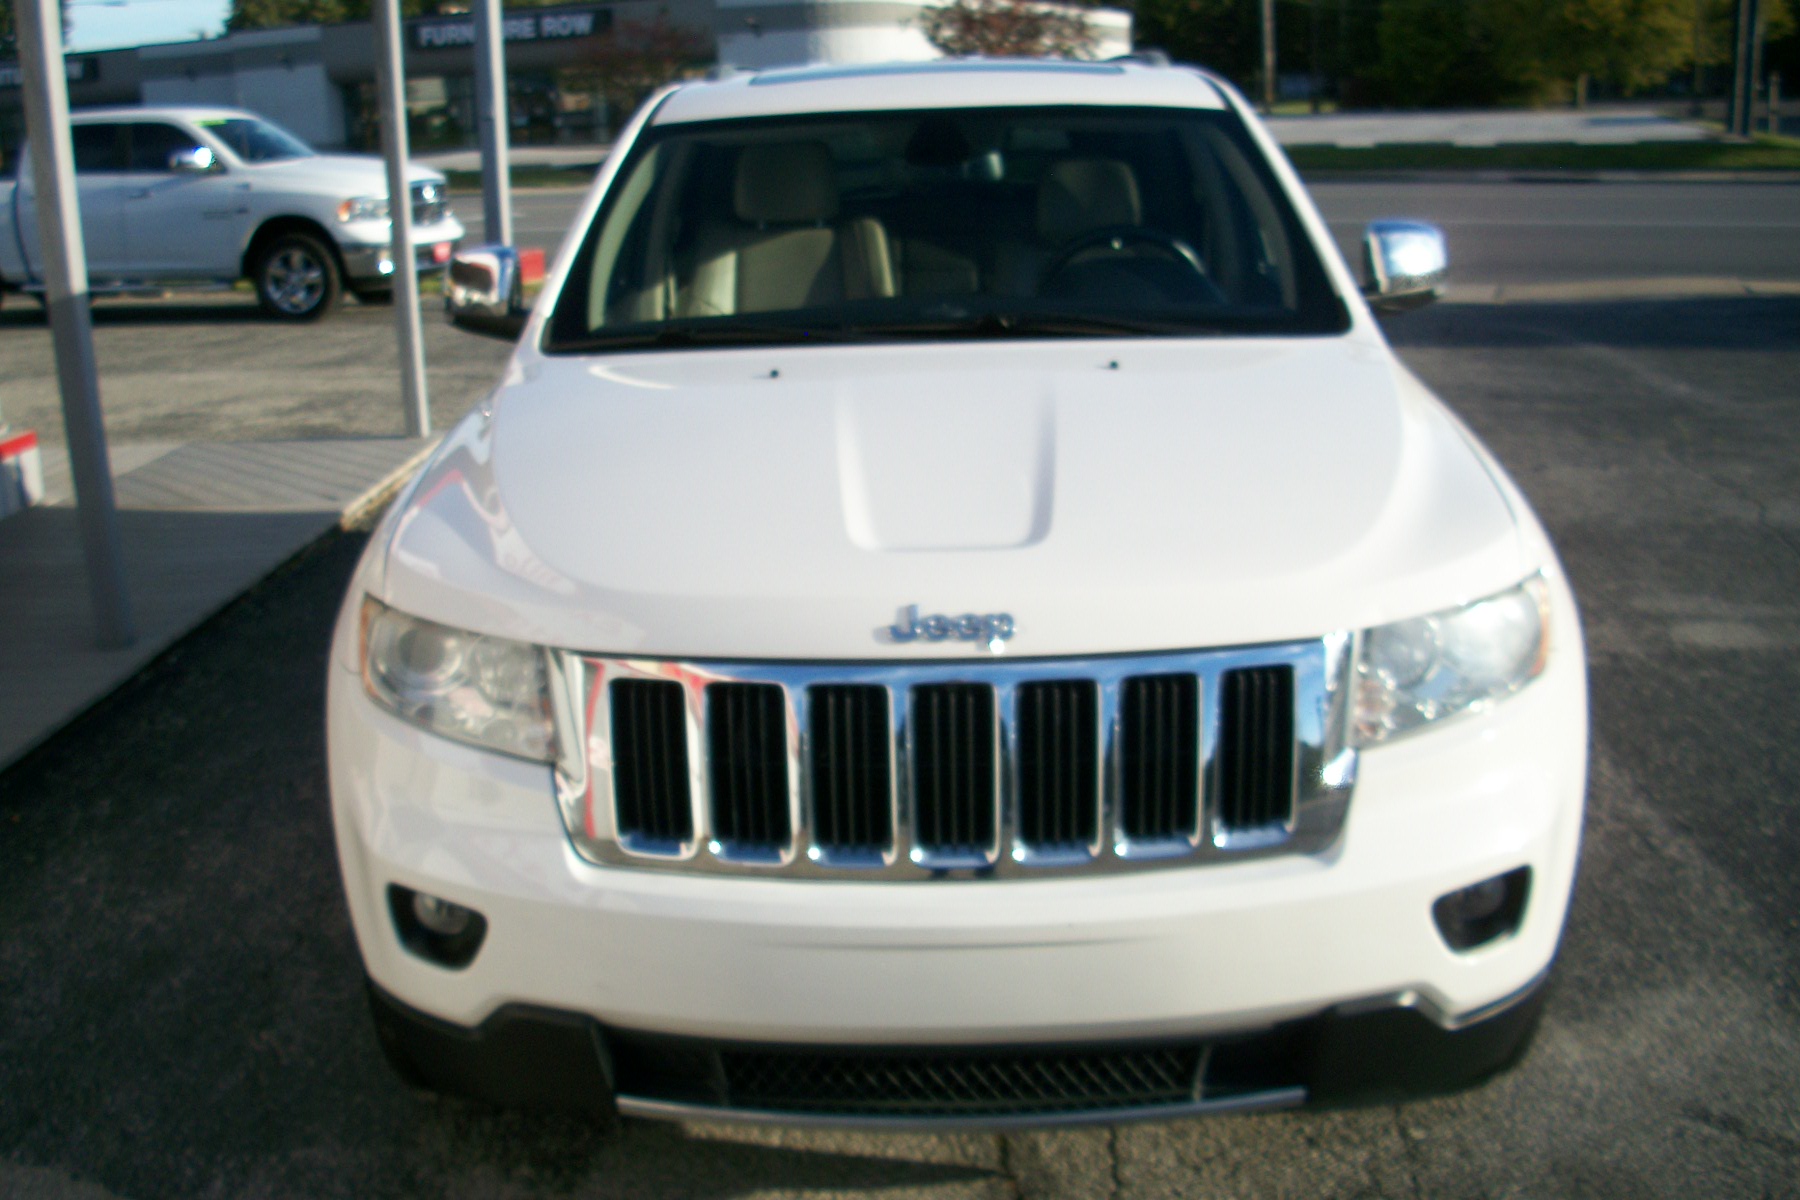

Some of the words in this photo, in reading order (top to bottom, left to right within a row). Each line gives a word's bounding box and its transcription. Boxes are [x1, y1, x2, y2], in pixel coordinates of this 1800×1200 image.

[419, 18, 537, 46] FURNRE
[541, 13, 595, 36] ROW
[887, 603, 1016, 654] Jeep
